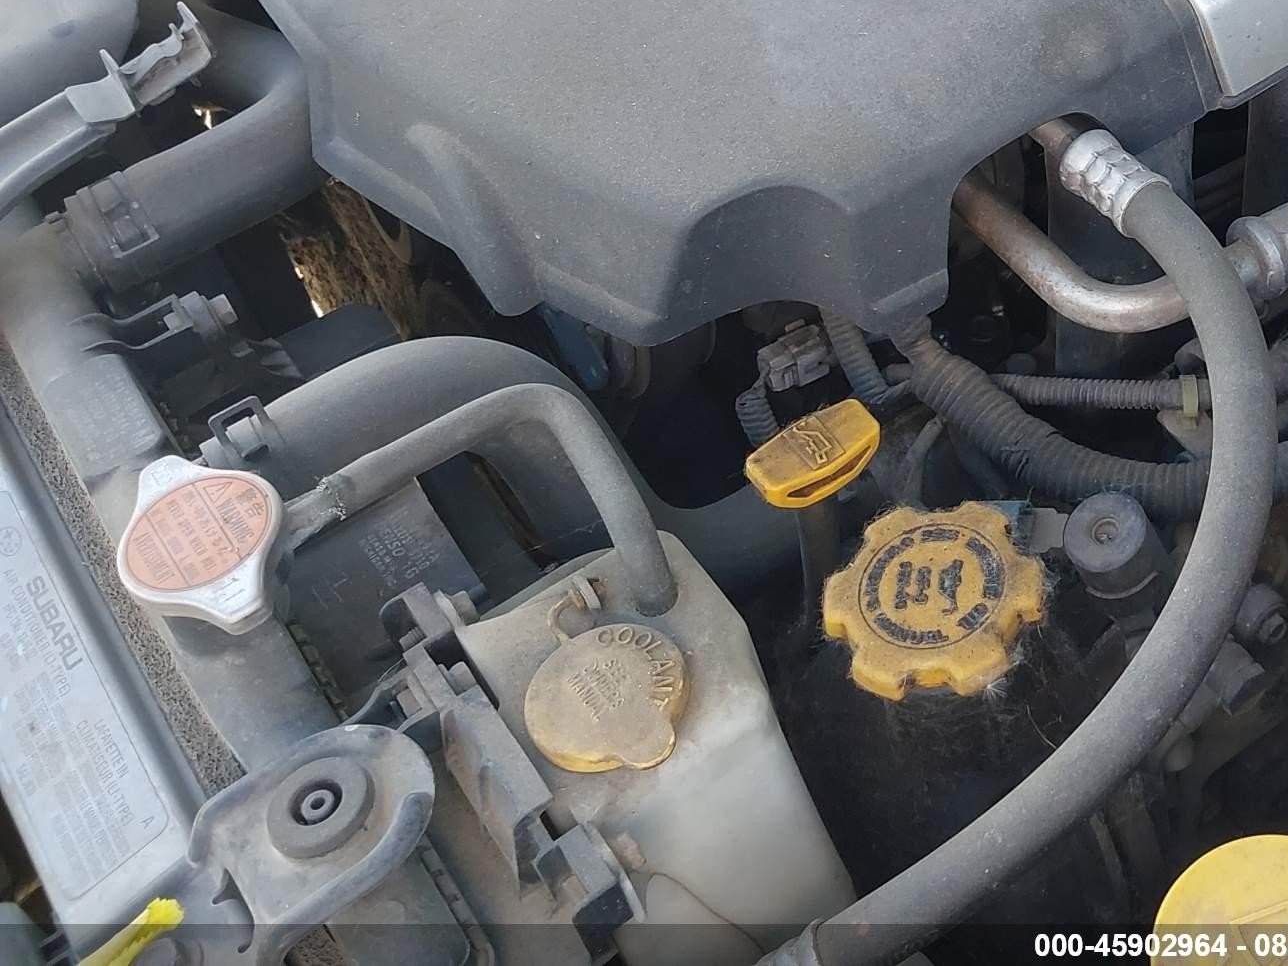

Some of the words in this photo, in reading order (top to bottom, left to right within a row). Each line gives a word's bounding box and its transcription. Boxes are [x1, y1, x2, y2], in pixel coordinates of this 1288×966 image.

[215, 497, 255, 546] WARNING
[2, 568, 18, 586] AIR
[10, 585, 50, 651] CONDITIONER
[23, 574, 84, 671] SUBARU
[564, 671, 609, 723] MANUAL
[598, 627, 676, 713] COOLANT
[601, 655, 631, 687] SEE
[75, 719, 113, 782] CLIMATISEUR
[93, 718, 124, 766] LAFAYETTE
[115, 763, 129, 778] IN
[139, 815, 156, 829] A
